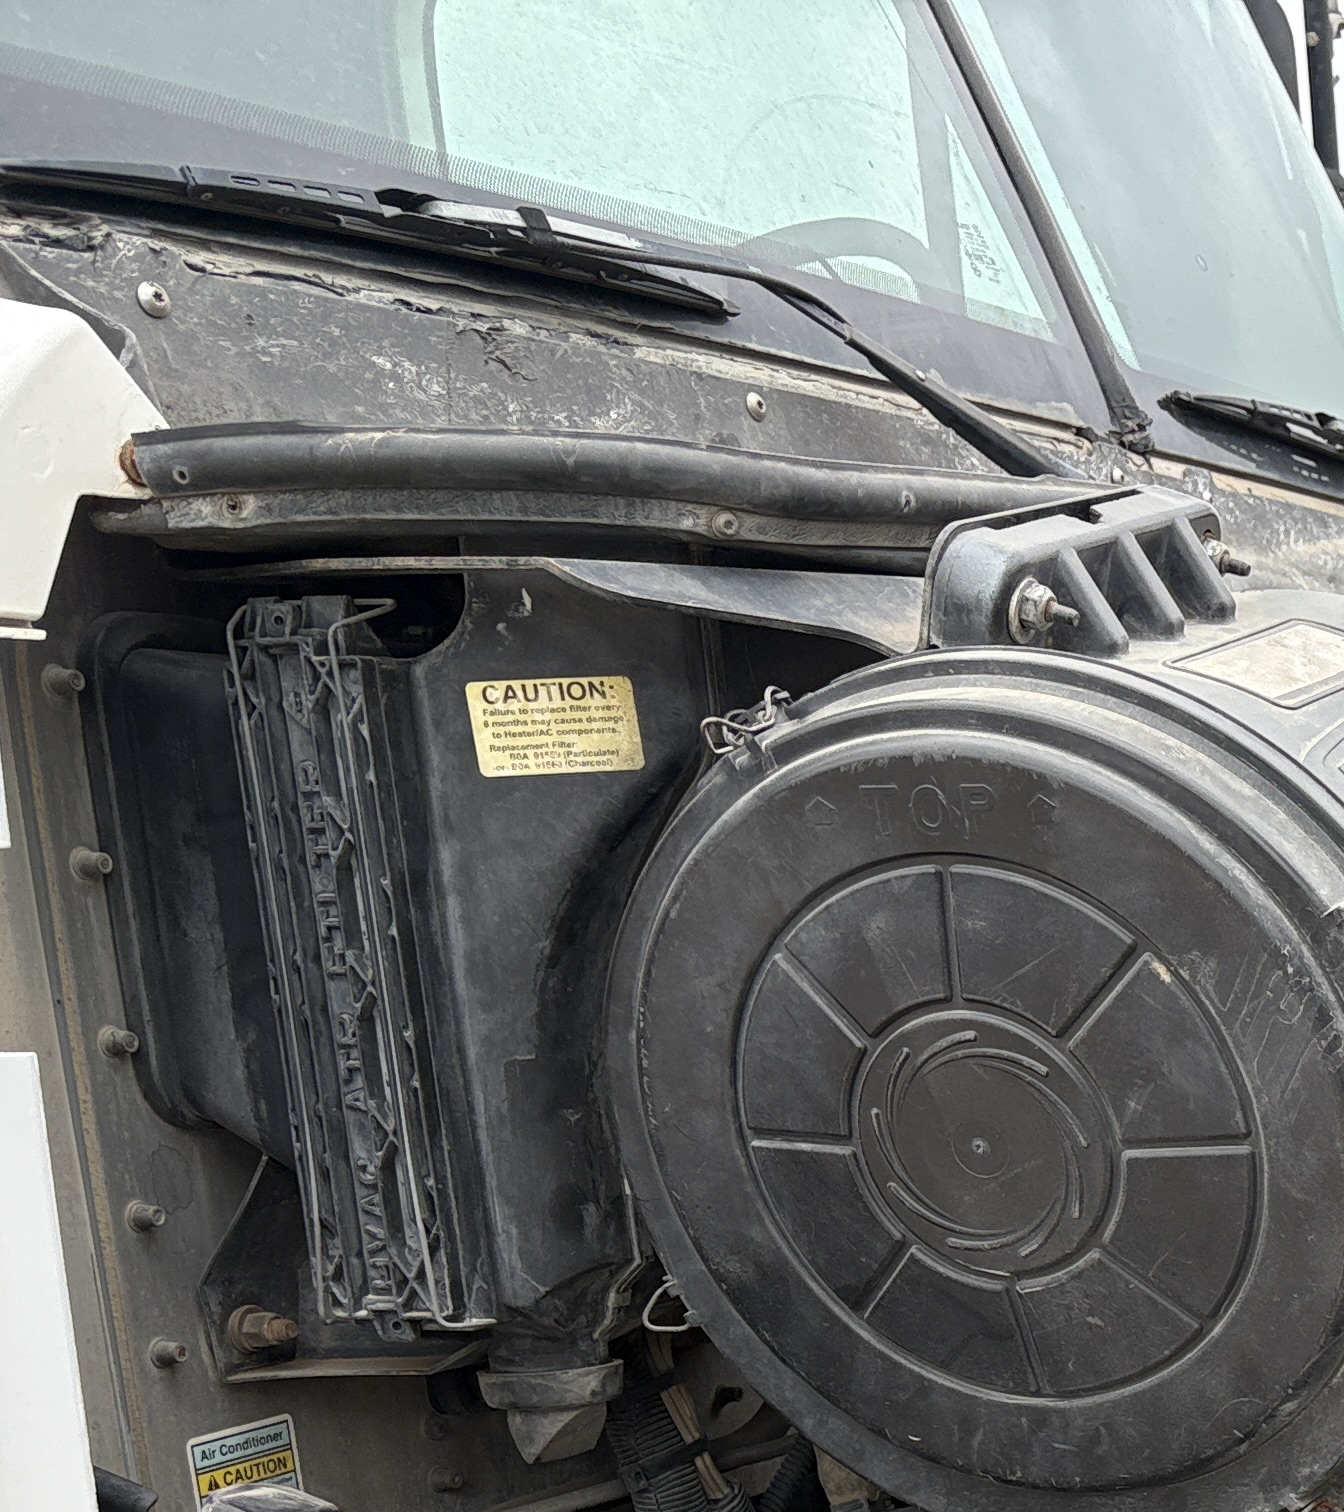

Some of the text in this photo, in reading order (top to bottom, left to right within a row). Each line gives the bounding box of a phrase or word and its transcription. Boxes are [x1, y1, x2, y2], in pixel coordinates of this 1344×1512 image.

[481, 680, 616, 705] CAUTION:
[482, 708, 516, 716] Failure
[518, 707, 529, 715] to
[530, 706, 567, 716] replace
[569, 704, 591, 713] filter
[492, 718, 529, 727] months
[531, 718, 551, 726] may
[554, 717, 584, 725] cause
[586, 715, 625, 724] damage
[491, 731, 502, 739] to
[857, 782, 997, 841] TOP
[200, 1430, 284, 1463] Air Conditioner
[222, 1455, 288, 1486] CAUTION
